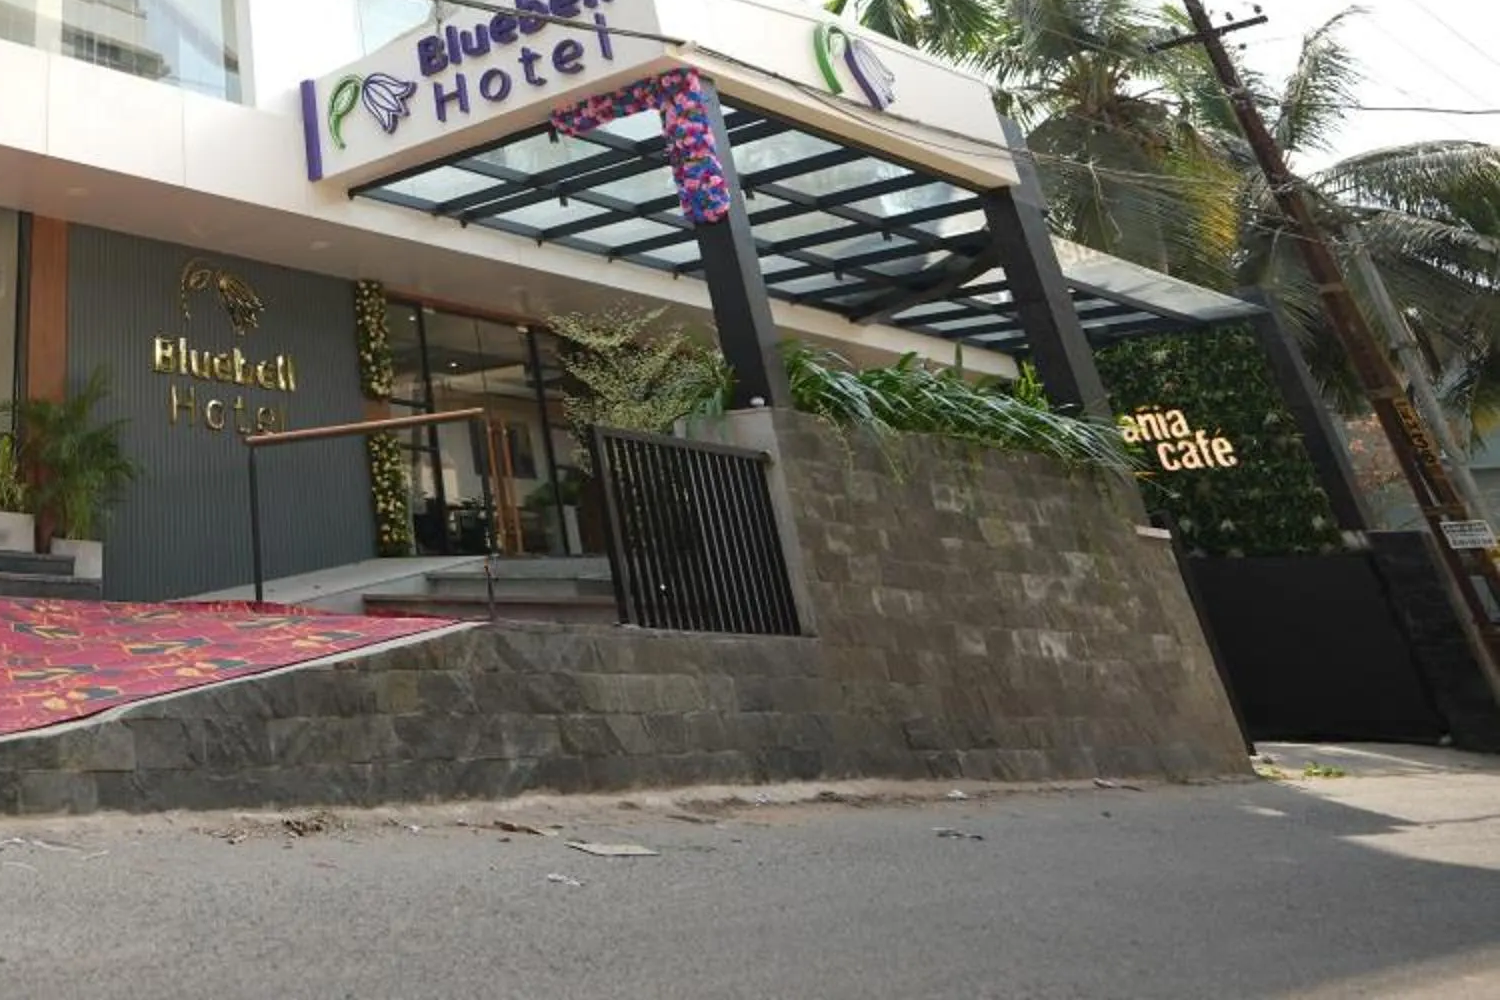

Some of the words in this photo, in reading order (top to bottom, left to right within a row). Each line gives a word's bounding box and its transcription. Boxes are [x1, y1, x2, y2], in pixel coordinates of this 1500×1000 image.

[433, 12, 614, 122] Hotel
[153, 335, 296, 392] Bluebell
[1157, 426, 1238, 471] café
